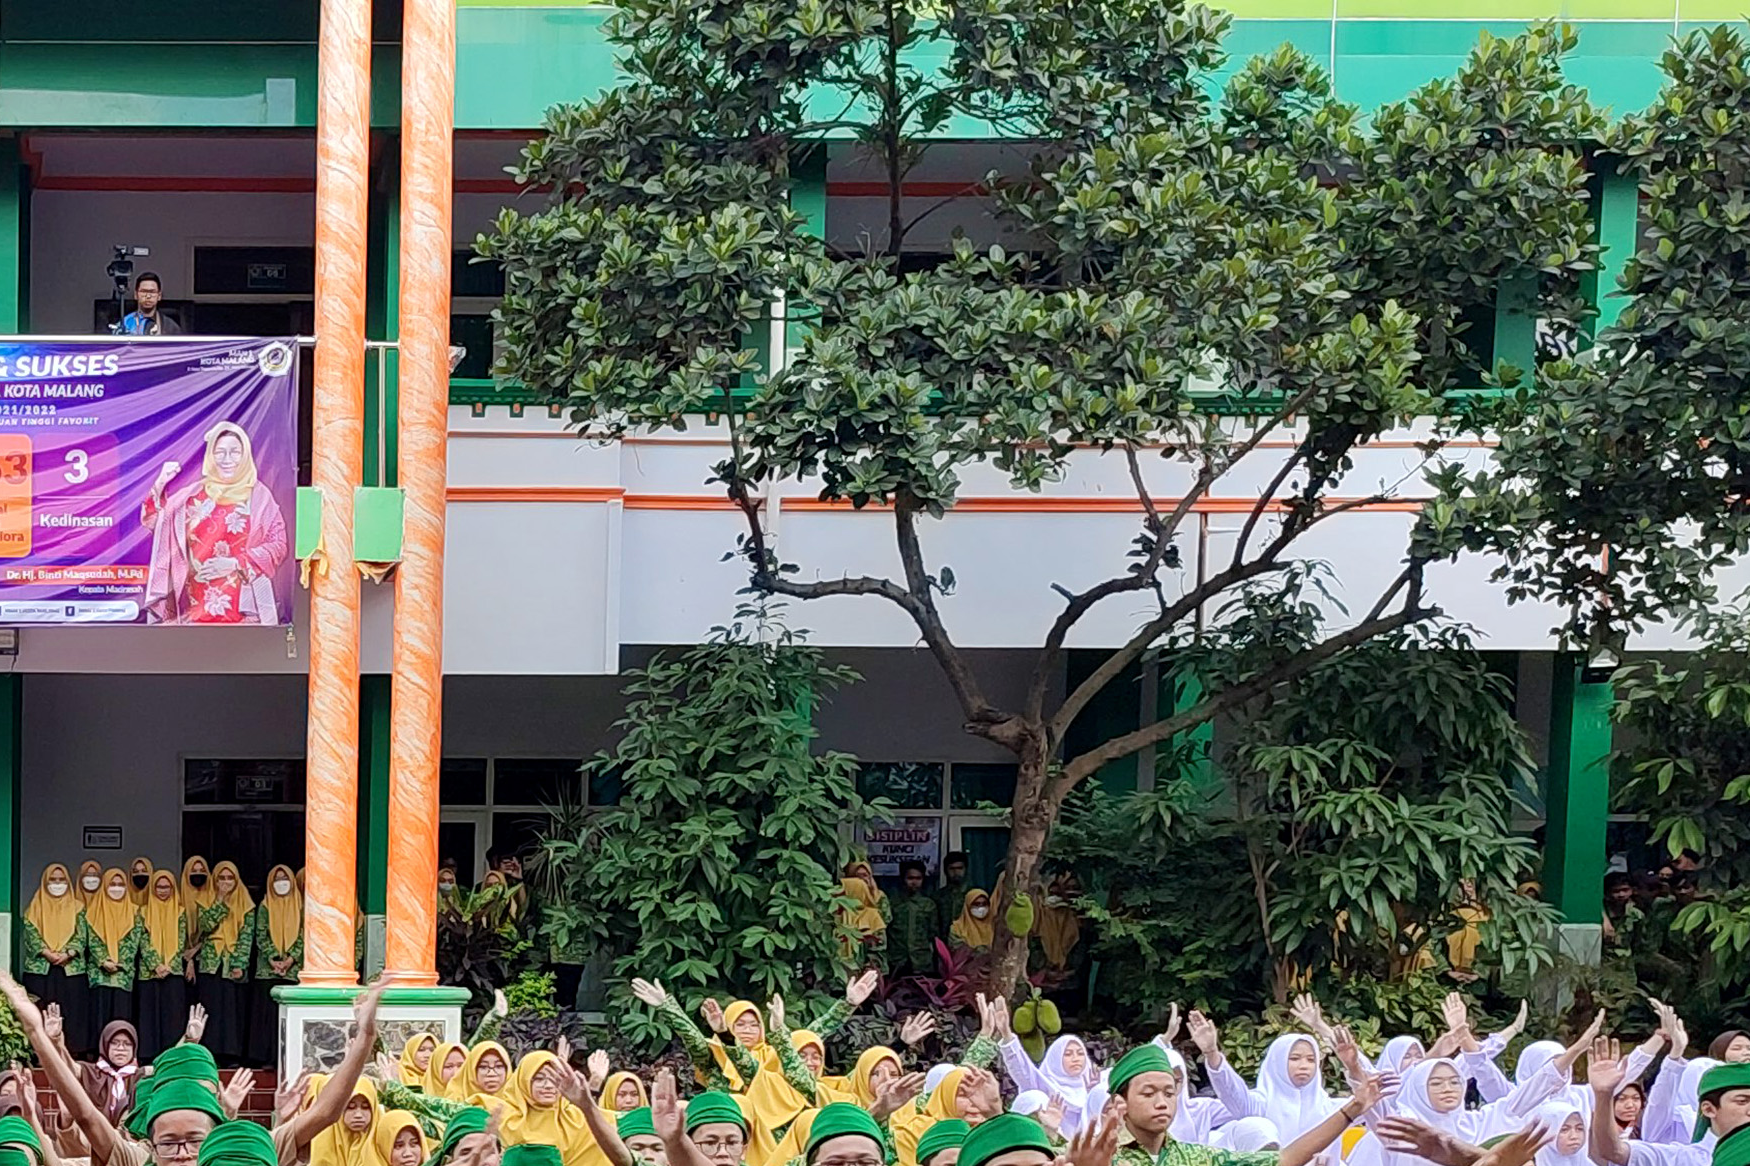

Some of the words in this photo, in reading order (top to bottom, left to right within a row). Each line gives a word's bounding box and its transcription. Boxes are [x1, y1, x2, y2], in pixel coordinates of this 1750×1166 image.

[14, 354, 120, 377] SUKSES
[4, 384, 41, 398] KOTA
[43, 383, 104, 398] MALANG
[21, 417, 55, 426] TINGGI
[58, 417, 100, 426] FAVORIT
[63, 449, 89, 484] 3
[39, 513, 113, 528] Kedinasan
